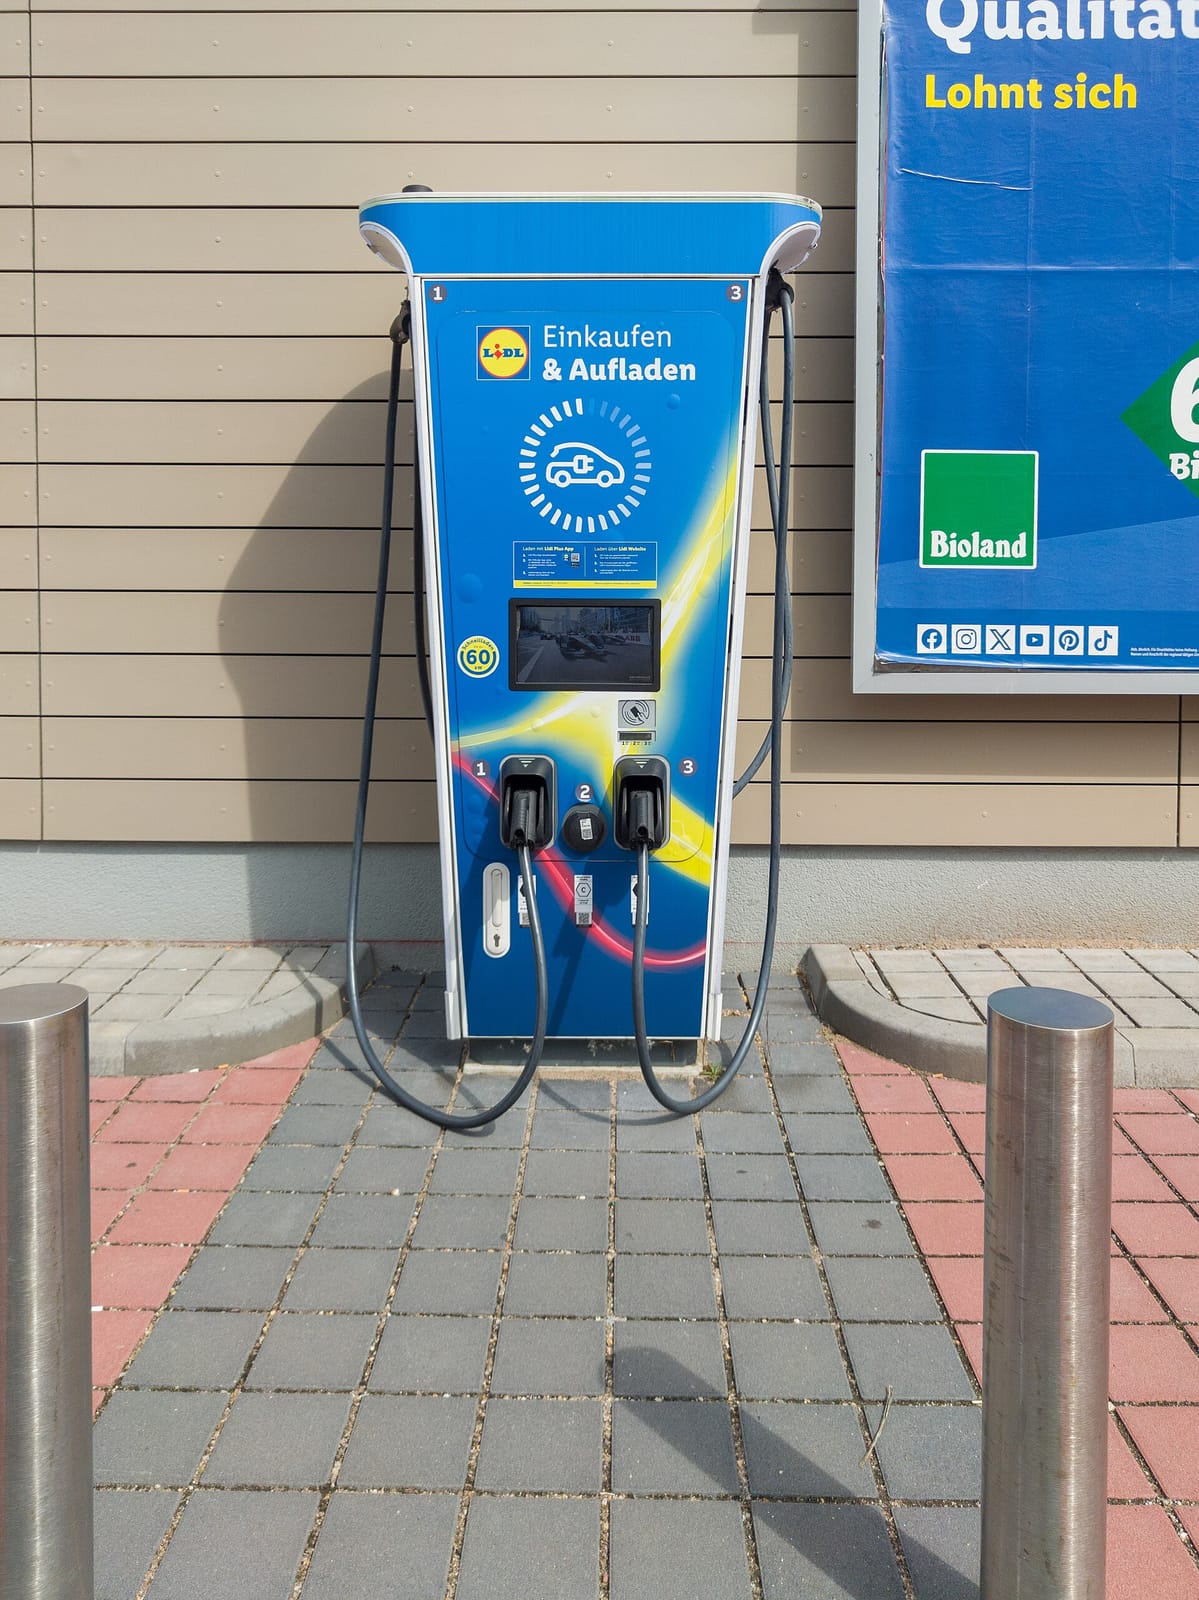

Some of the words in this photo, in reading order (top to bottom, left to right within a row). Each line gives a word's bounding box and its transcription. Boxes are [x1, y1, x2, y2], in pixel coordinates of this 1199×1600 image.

[925, 74, 1042, 109] Lohnt
[1054, 73, 1137, 109] sich
[433, 286, 443, 300] 1
[731, 286, 742, 300] 3
[543, 324, 672, 348] Einkaufen
[542, 358, 562, 381] &
[569, 358, 696, 381] Aufladen
[930, 530, 1027, 559] Bioland
[466, 649, 490, 665] 60
[476, 762, 486, 776] 1
[683, 760, 694, 774] 3
[579, 785, 590, 799] 2
